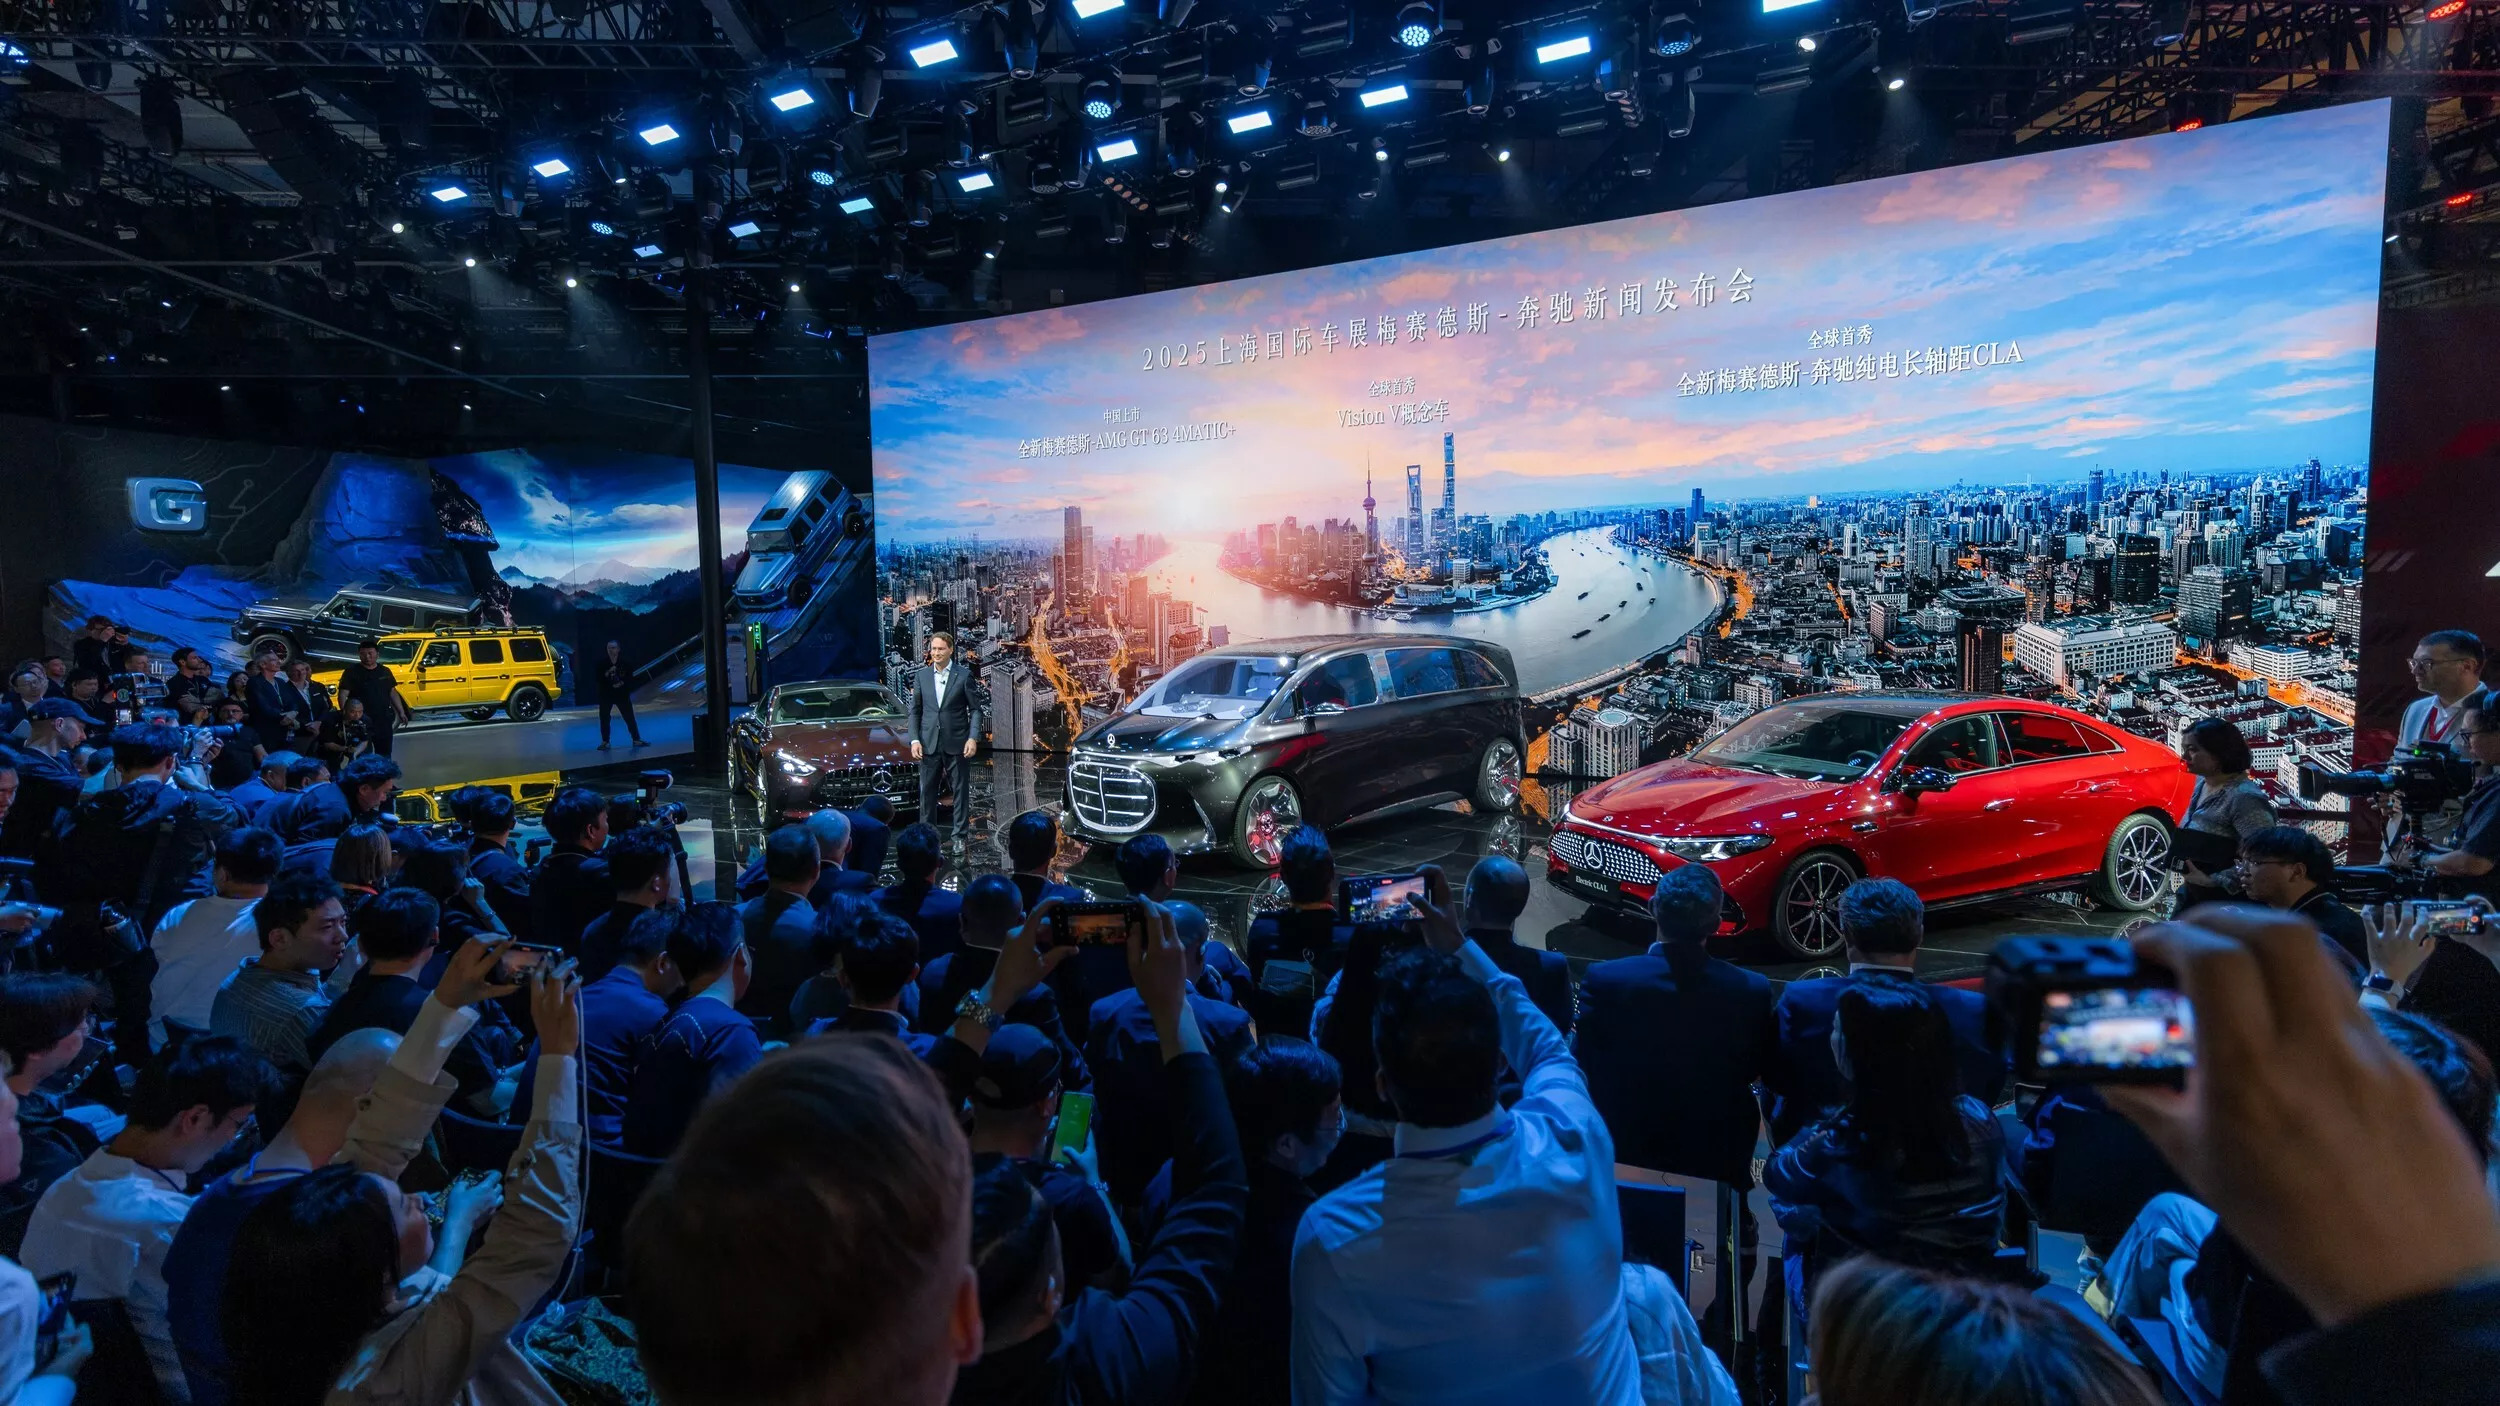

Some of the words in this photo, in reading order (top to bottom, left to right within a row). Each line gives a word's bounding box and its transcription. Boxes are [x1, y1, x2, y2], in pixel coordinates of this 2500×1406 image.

[1141, 267, 1756, 372] 2025上海国际车展梅赛德斯-奔驰新闻发布会
[1807, 324, 1874, 350] 全球首秀
[1676, 340, 2024, 398] 全新梅赛德斯-奔驰纯电长轴距CLA
[1368, 377, 1415, 398] 全球首秀
[1103, 406, 1141, 425] 中国上市
[1336, 407, 1385, 428] Vision
[1388, 398, 1450, 425] V概念车
[1018, 432, 1127, 459] 全新梅赛德斯-AMG
[1130, 430, 1150, 447] GT
[1151, 426, 1169, 445] 63
[1172, 422, 1237, 443] 4MATIC+
[127, 477, 207, 531] G
[1575, 875, 1593, 888] Electric
